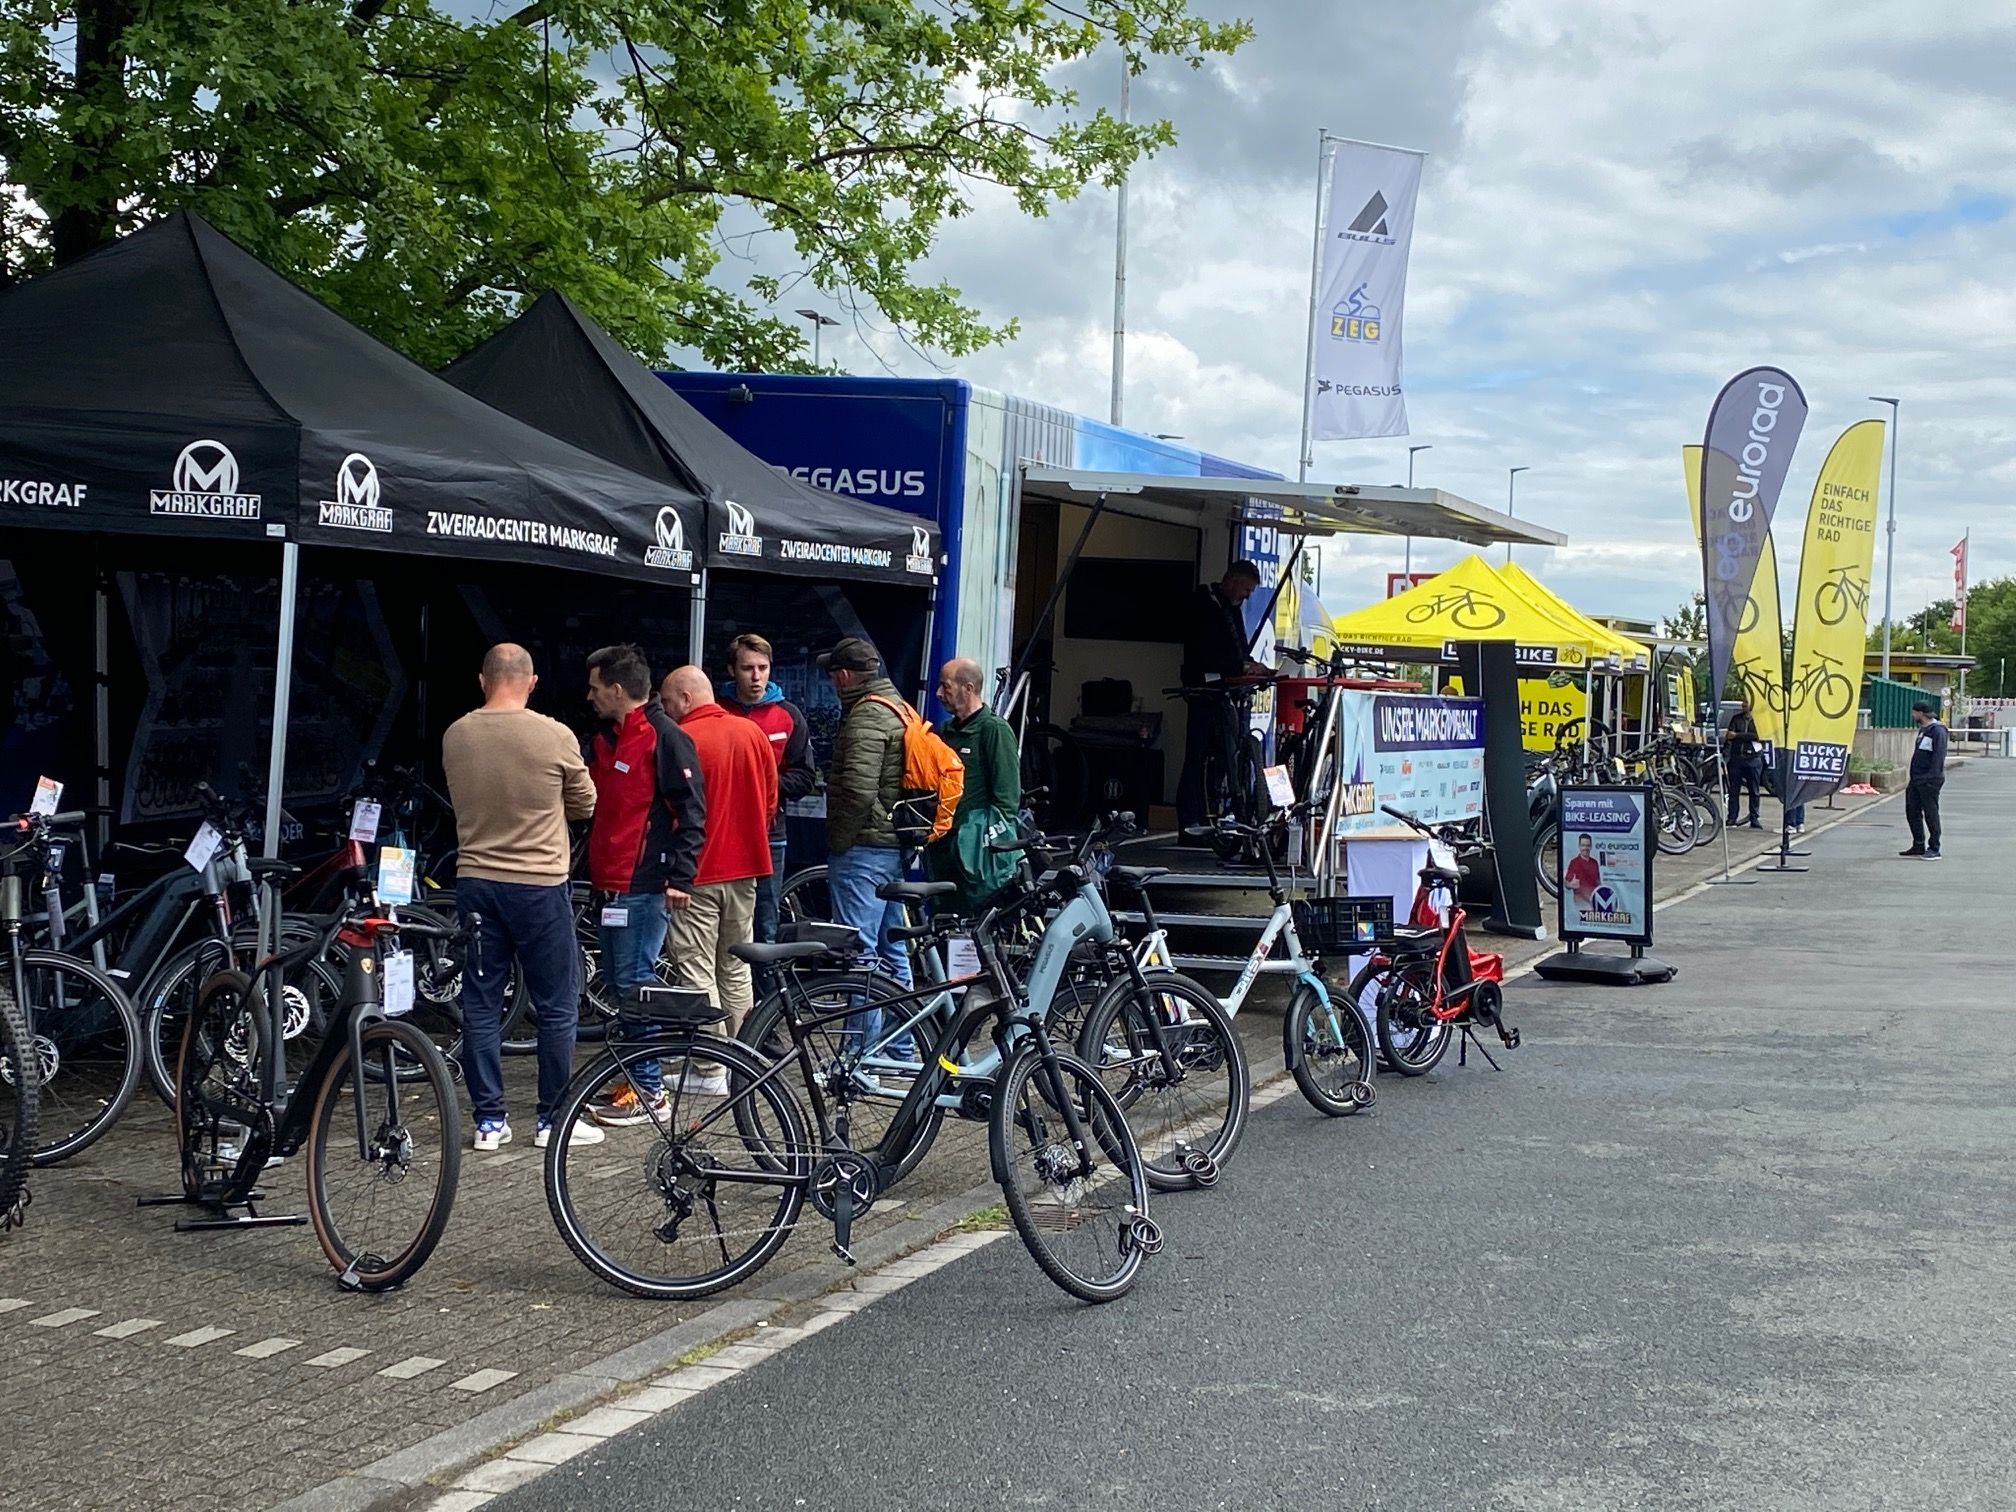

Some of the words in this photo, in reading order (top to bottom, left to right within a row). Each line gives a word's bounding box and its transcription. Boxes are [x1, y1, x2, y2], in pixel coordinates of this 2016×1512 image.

[1333, 317, 1380, 340] ZEG
[1336, 384, 1401, 397] PEGASUS
[1728, 382, 1785, 523] eurorad
[1823, 483, 1869, 502] EINFACH
[152, 493, 259, 517] MARKGRAF
[1821, 497, 1843, 512] DAS
[320, 504, 391, 530] MARKGRAF
[1819, 512, 1871, 533] RICHTIGE
[426, 511, 547, 545] ZWEIRADCENTER
[550, 525, 619, 557] MARKGRAF
[1817, 527, 1840, 543] RAD
[720, 535, 761, 556] MARKGRAF
[780, 539, 850, 563] ZWEIRADCENTER
[851, 547, 892, 568] MARKGRAF
[646, 547, 691, 568] MARKGRAF
[1538, 701, 1572, 717] DAS
[1800, 744, 1846, 757] LUCKY
[1799, 755, 1842, 771] BIKE
[1565, 798, 1596, 810] Sparen
[1598, 799, 1614, 809] mit
[1565, 812, 1630, 823] BIKE-LEASING
[1580, 911, 1631, 924] MARKGRAF
